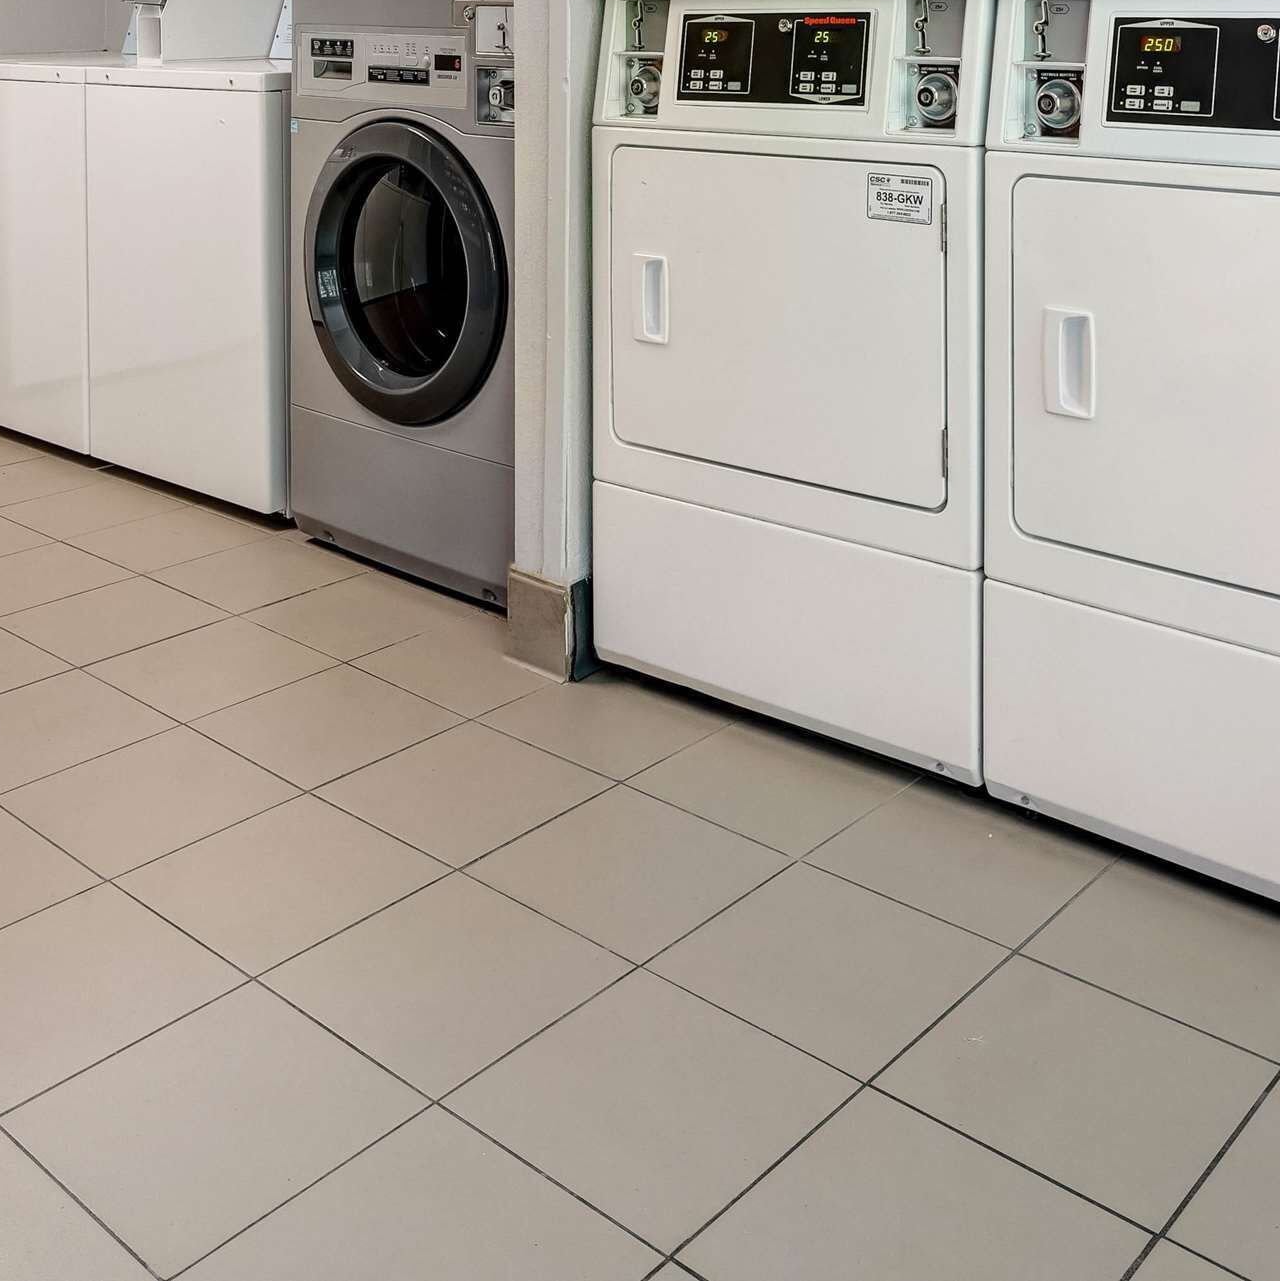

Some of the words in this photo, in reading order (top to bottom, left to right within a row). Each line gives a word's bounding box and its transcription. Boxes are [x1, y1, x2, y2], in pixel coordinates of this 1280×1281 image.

[705, 32, 718, 42] 25
[814, 32, 829, 43] 25
[1144, 38, 1173, 51] 250
[876, 192, 924, 205] 838-GKW
